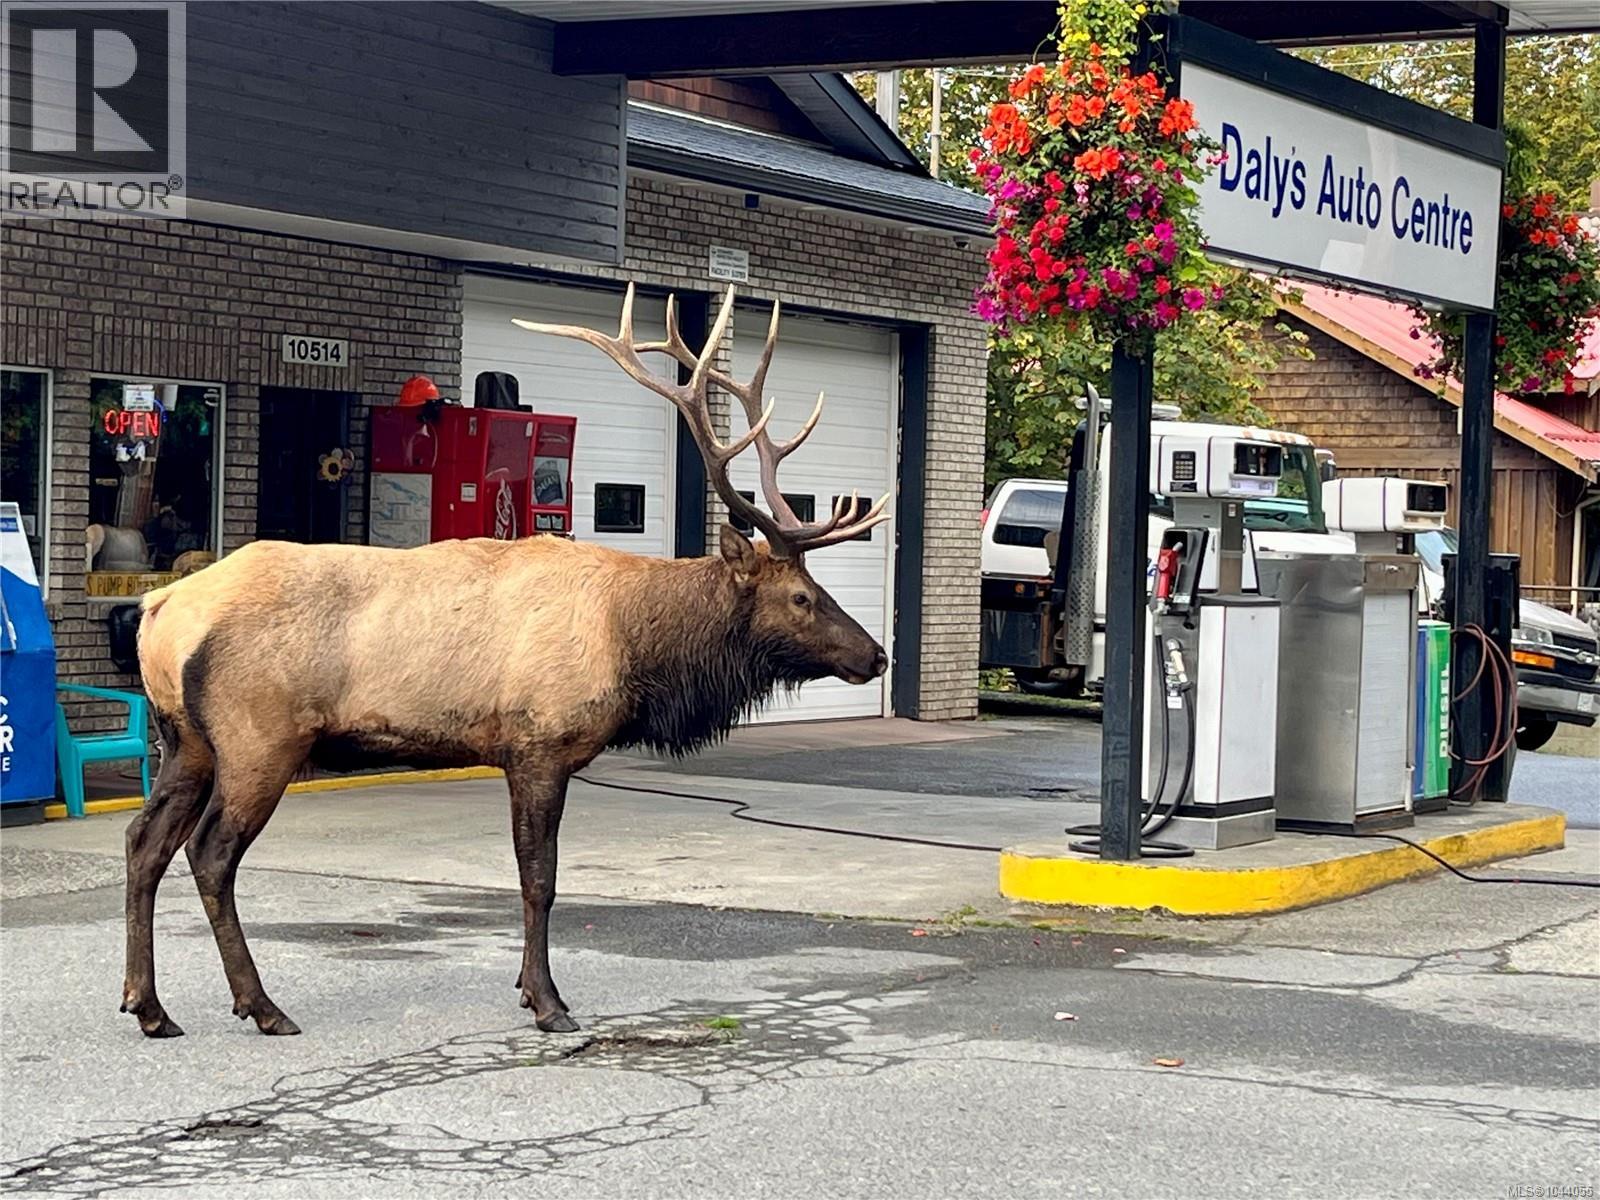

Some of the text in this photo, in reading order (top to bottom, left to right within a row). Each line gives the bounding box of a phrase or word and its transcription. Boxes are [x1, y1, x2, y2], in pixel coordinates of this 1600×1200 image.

[1220, 122, 1473, 254] Daly's Auto Centre
[288, 338, 341, 363] 10514
[104, 409, 160, 437] OPEN
[1440, 662, 1450, 758] DIESEL
